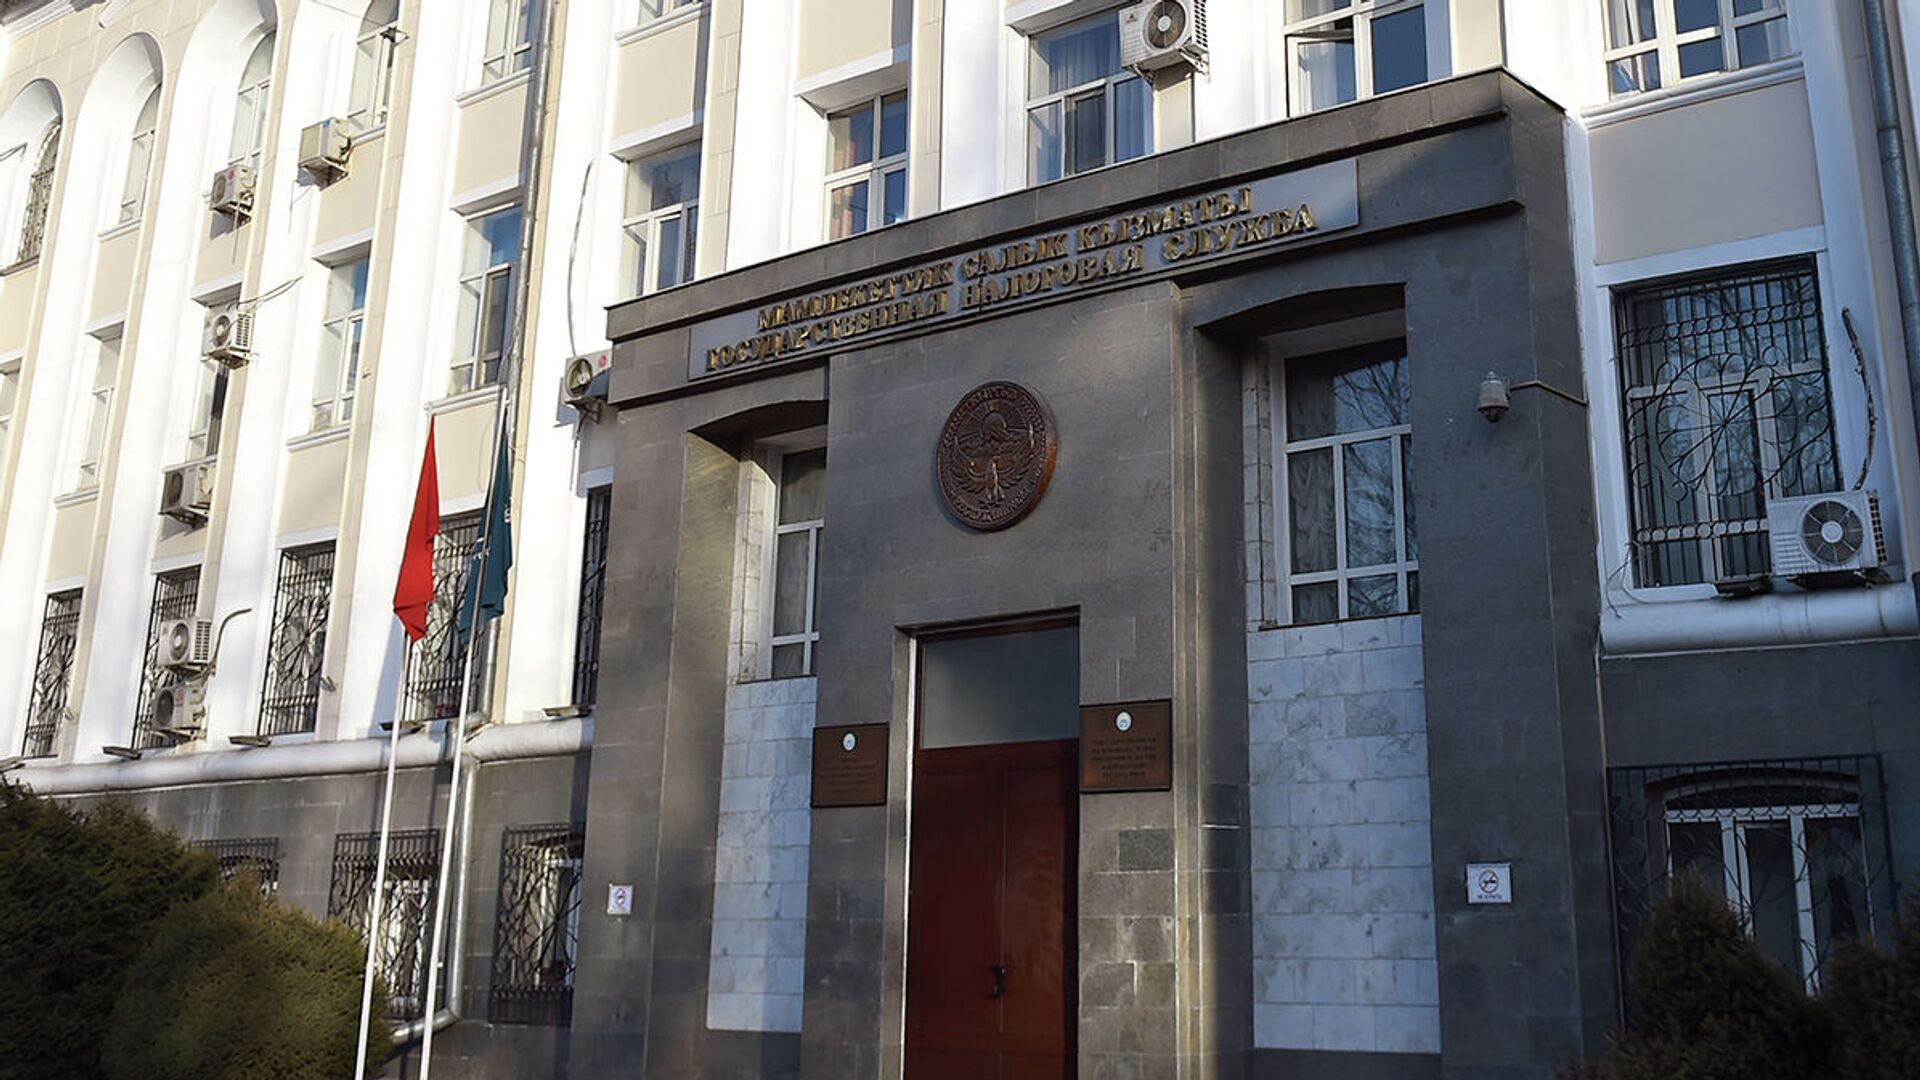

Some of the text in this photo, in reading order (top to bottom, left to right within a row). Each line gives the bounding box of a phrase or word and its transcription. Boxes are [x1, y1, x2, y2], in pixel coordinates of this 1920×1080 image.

[706, 203, 1318, 371] ГОСУДАРСТВЕННАЯ НАЛОГОВАЯ СЛУЖБА
[758, 187, 1251, 331] МАМЛЕКЕТТИК САЛЫК КЫЗМАТЫ
